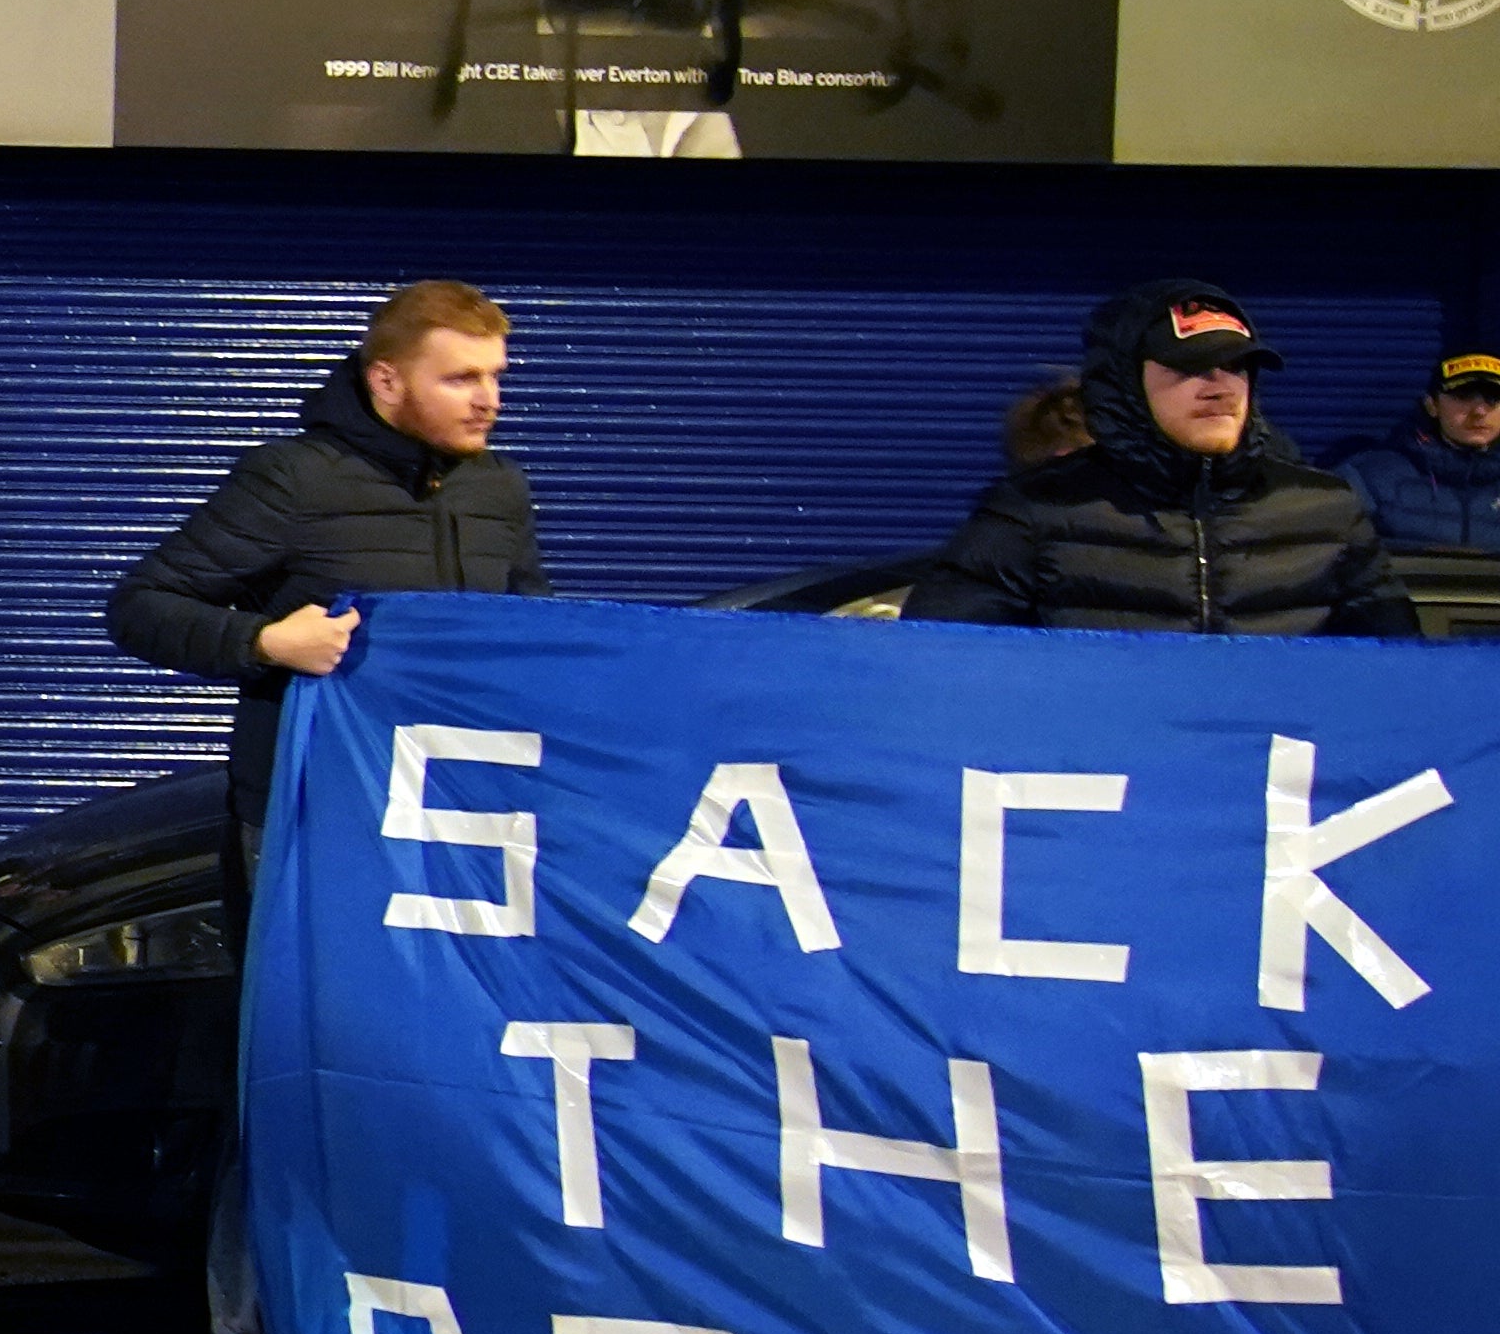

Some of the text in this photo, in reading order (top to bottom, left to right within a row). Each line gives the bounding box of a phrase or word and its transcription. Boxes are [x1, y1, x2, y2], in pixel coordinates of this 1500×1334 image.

[324, 60, 370, 78] 1999
[373, 60, 398, 78] Bill
[484, 63, 521, 81] CBE
[523, 63, 566, 82] takes
[569, 67, 606, 83] ver
[608, 66, 671, 84] Everton
[673, 67, 708, 85] with
[738, 68, 775, 86] True
[776, 68, 814, 87] Blue
[380, 723, 1455, 1012] SACK
[499, 1020, 1343, 1305] THE
